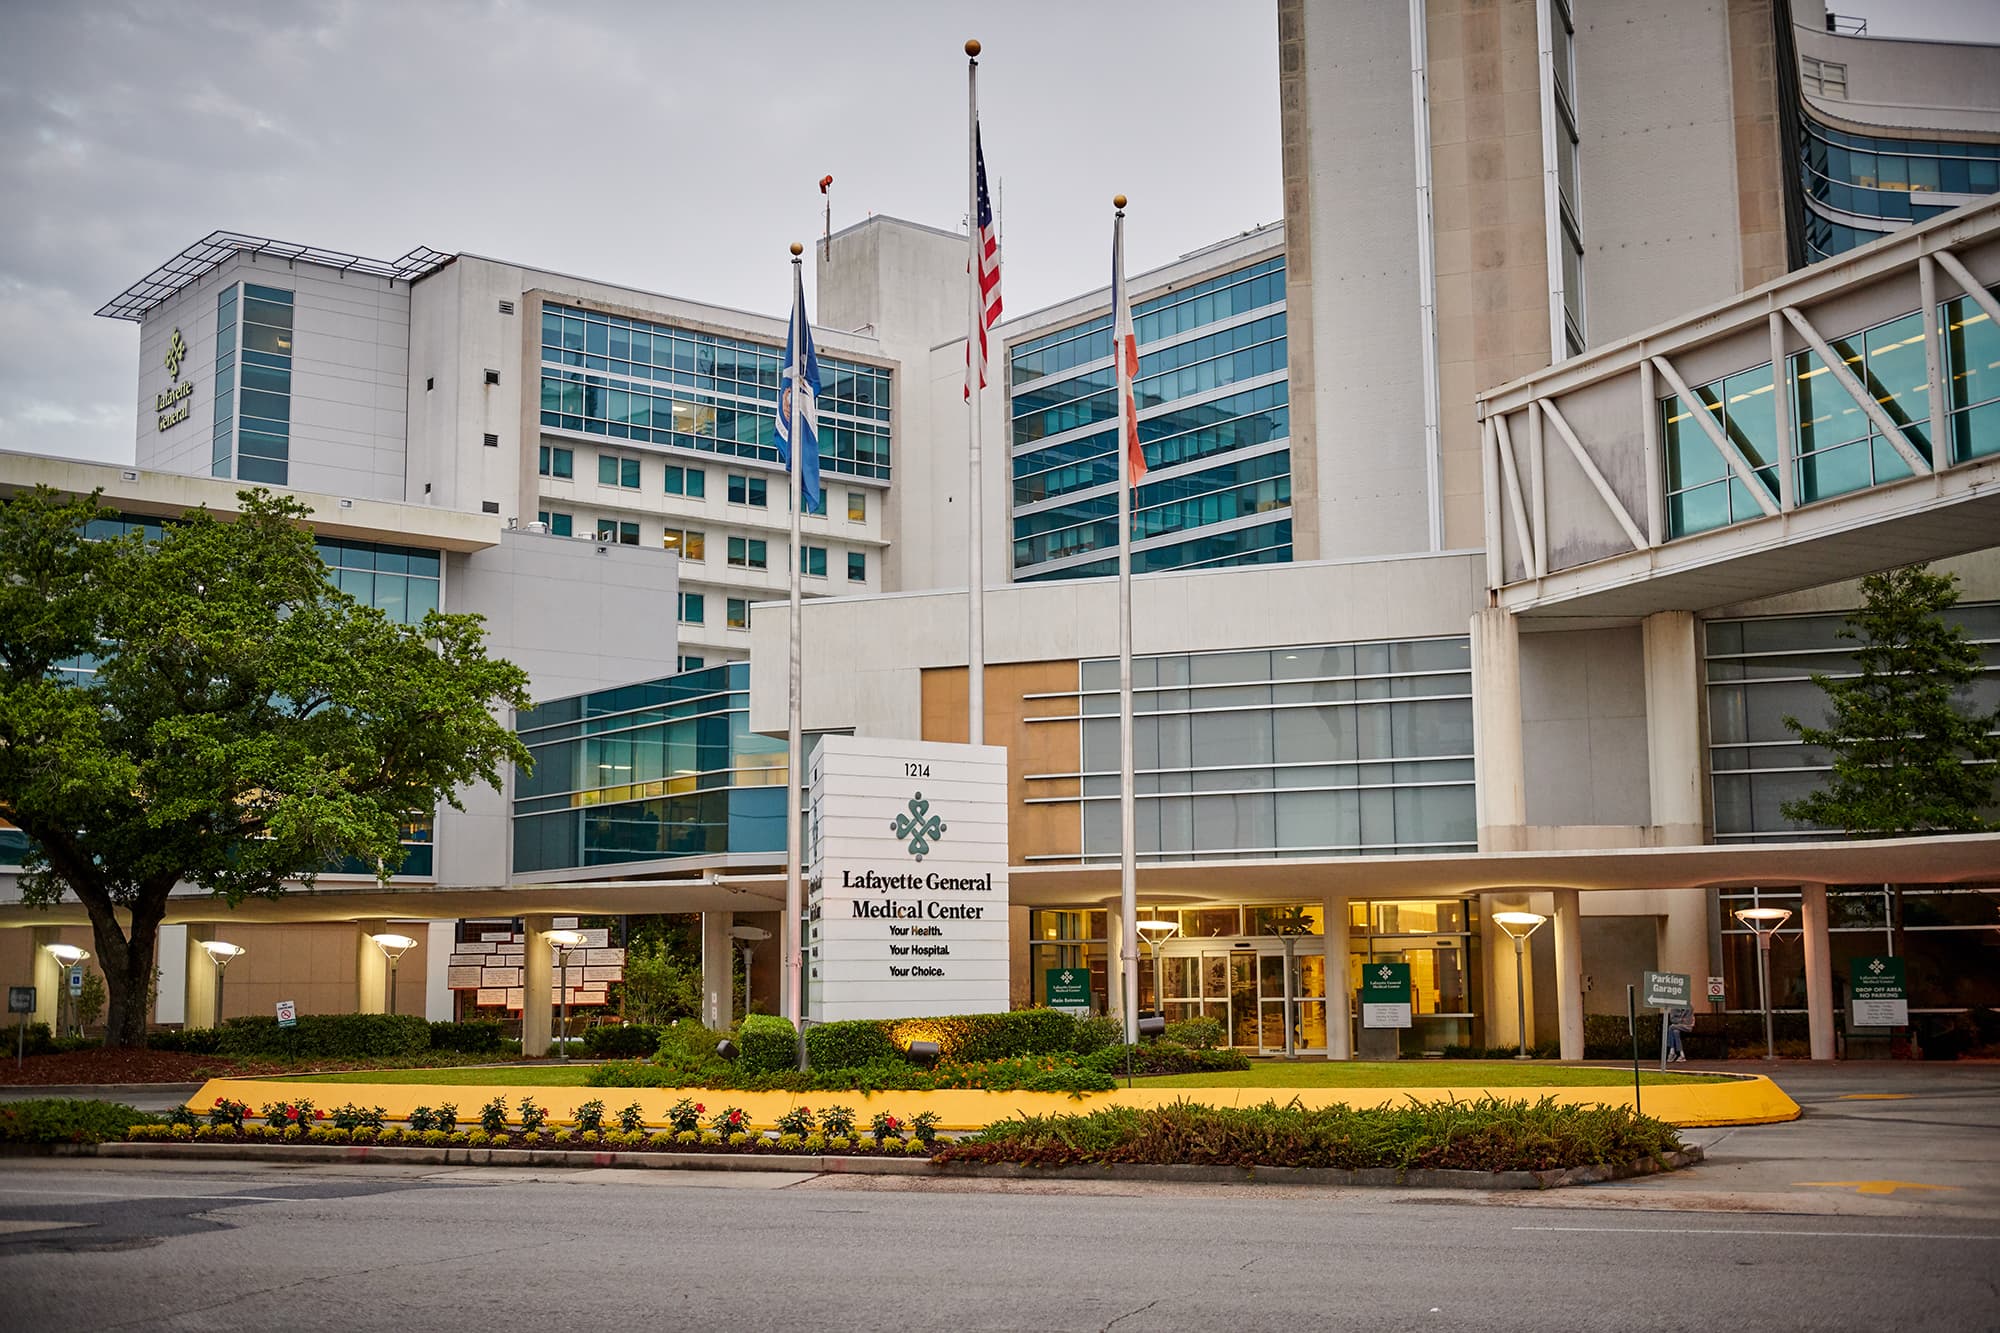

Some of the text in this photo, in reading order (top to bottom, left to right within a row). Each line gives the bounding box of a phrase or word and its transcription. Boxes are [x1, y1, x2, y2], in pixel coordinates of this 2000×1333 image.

[156, 381, 193, 412] Lafayette
[159, 399, 190, 432] General
[905, 763, 930, 777] 1214
[842, 870, 923, 893] Lafayette
[926, 872, 992, 891] General
[852, 900, 984, 919] Medical Center
[889, 925, 942, 936] Your Health.
[889, 945, 950, 957] Your Hospital.
[889, 966, 945, 976] Your Choice.
[1652, 974, 1684, 986] Parking
[1653, 984, 1682, 995] Garage
